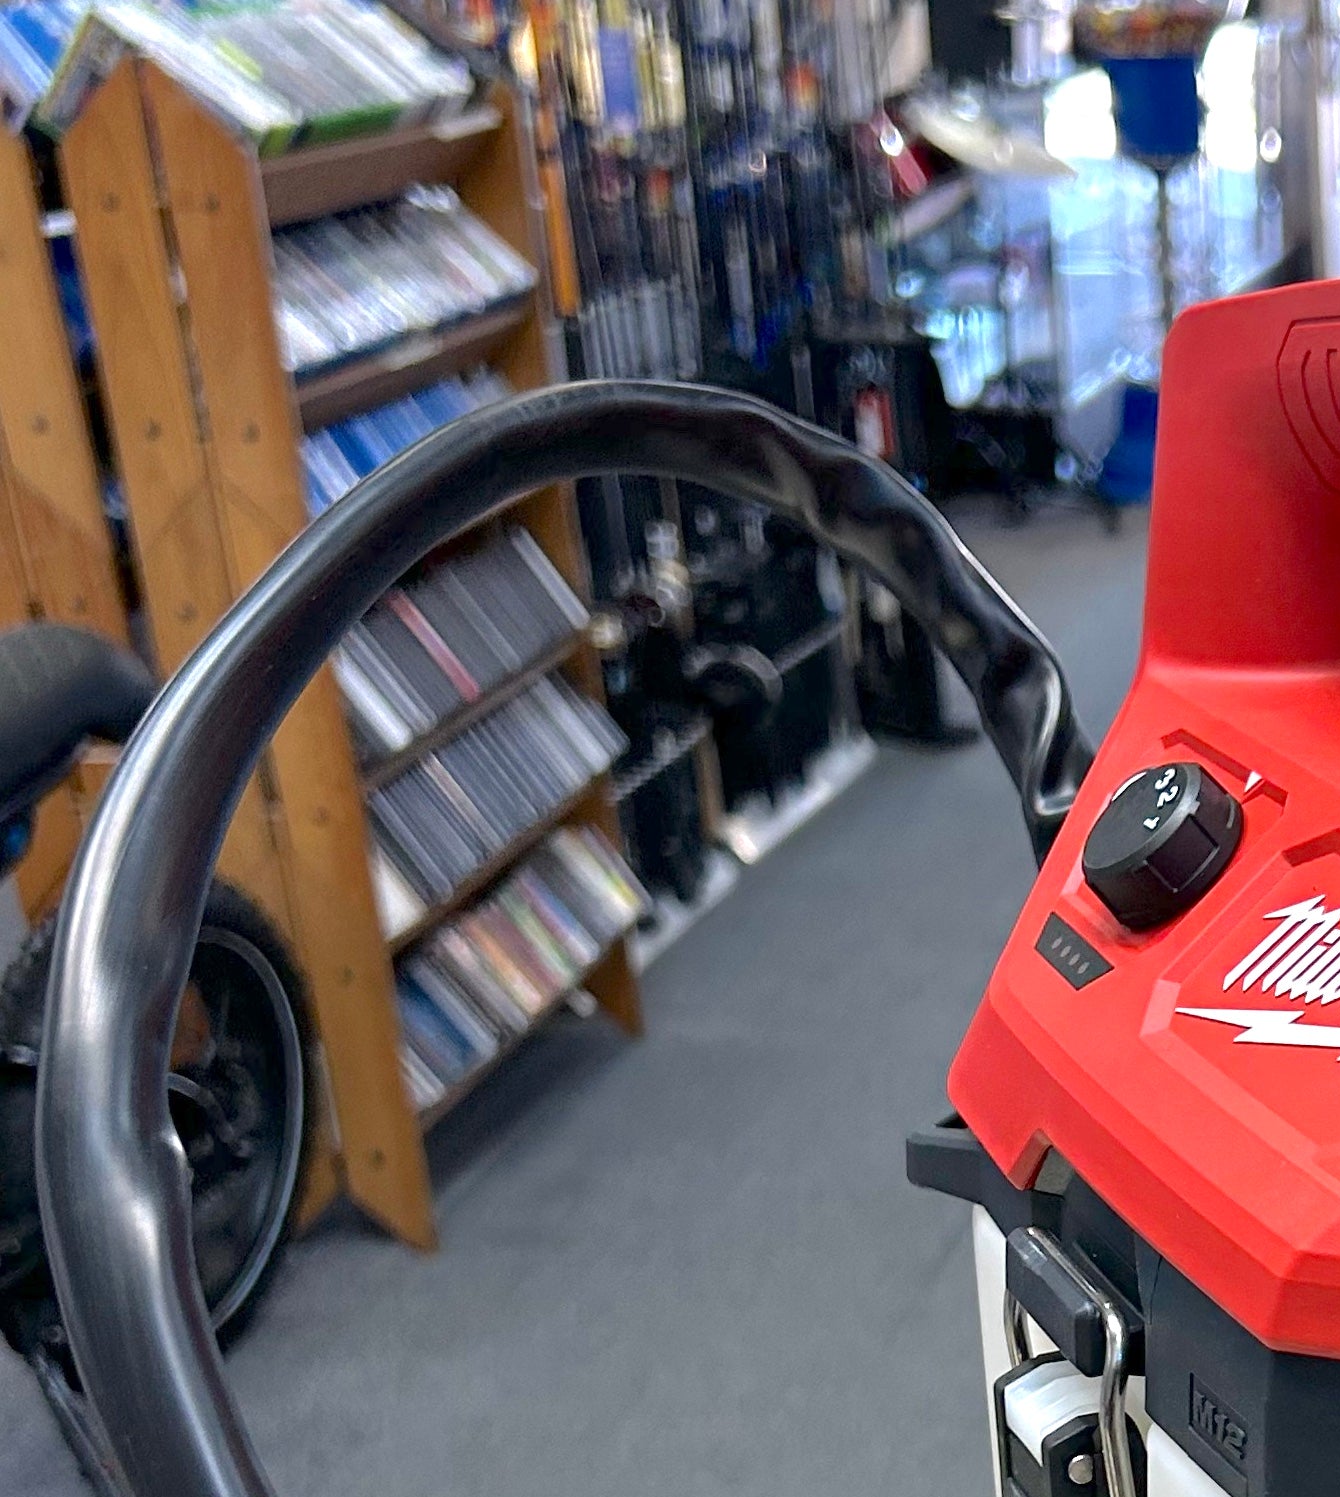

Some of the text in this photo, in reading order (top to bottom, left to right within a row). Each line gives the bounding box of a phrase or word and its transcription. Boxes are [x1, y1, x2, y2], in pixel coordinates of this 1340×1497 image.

[1155, 768, 1176, 790] 3
[1157, 785, 1179, 807] 2
[1143, 816, 1160, 830] 1
[1191, 1389, 1249, 1462] M12
